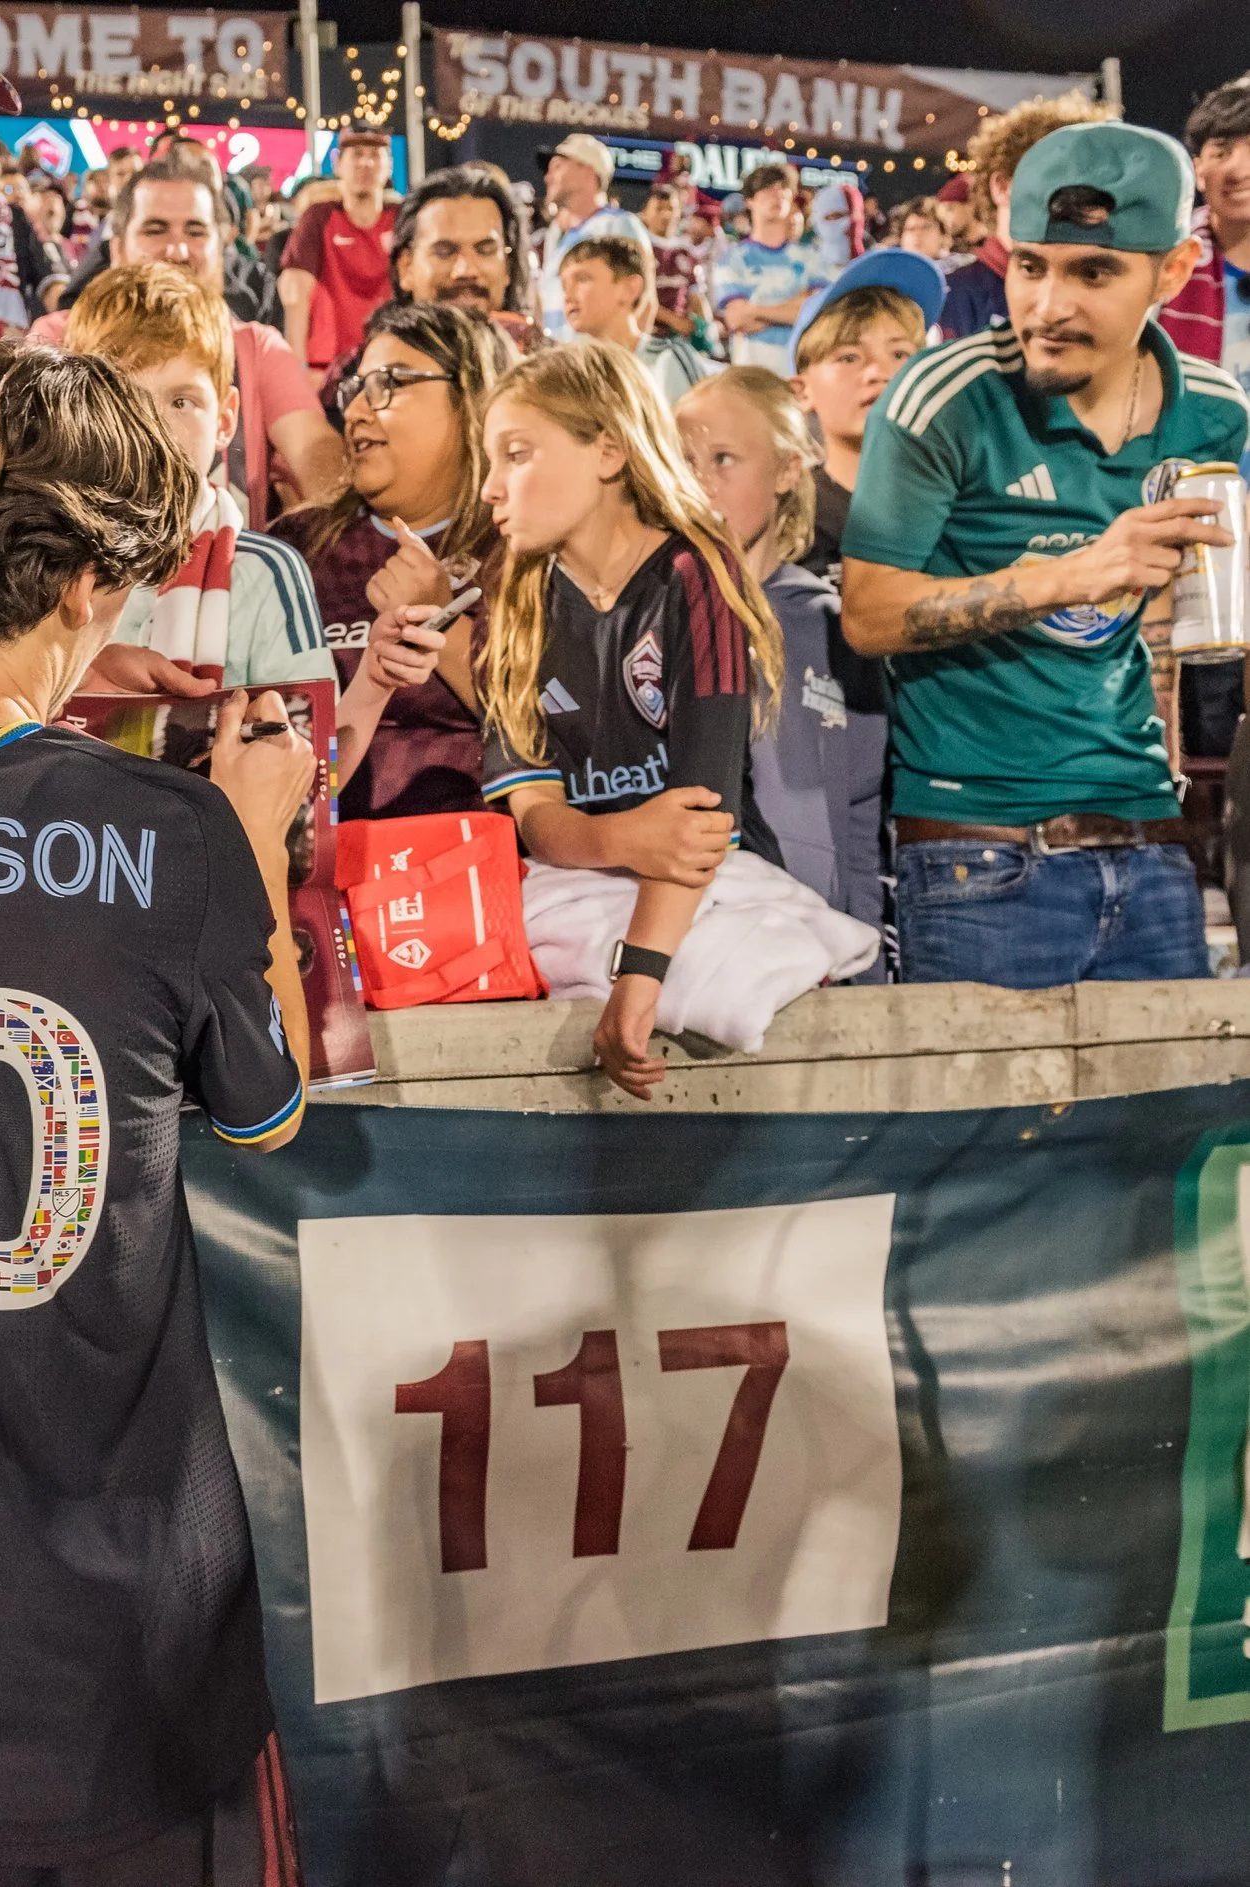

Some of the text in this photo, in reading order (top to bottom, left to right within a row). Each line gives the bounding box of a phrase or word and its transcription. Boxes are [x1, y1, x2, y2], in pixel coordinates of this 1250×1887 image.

[168, 16, 264, 75] TO
[461, 37, 905, 151] SOUTH BANK
[394, 1321, 790, 1574] 117
